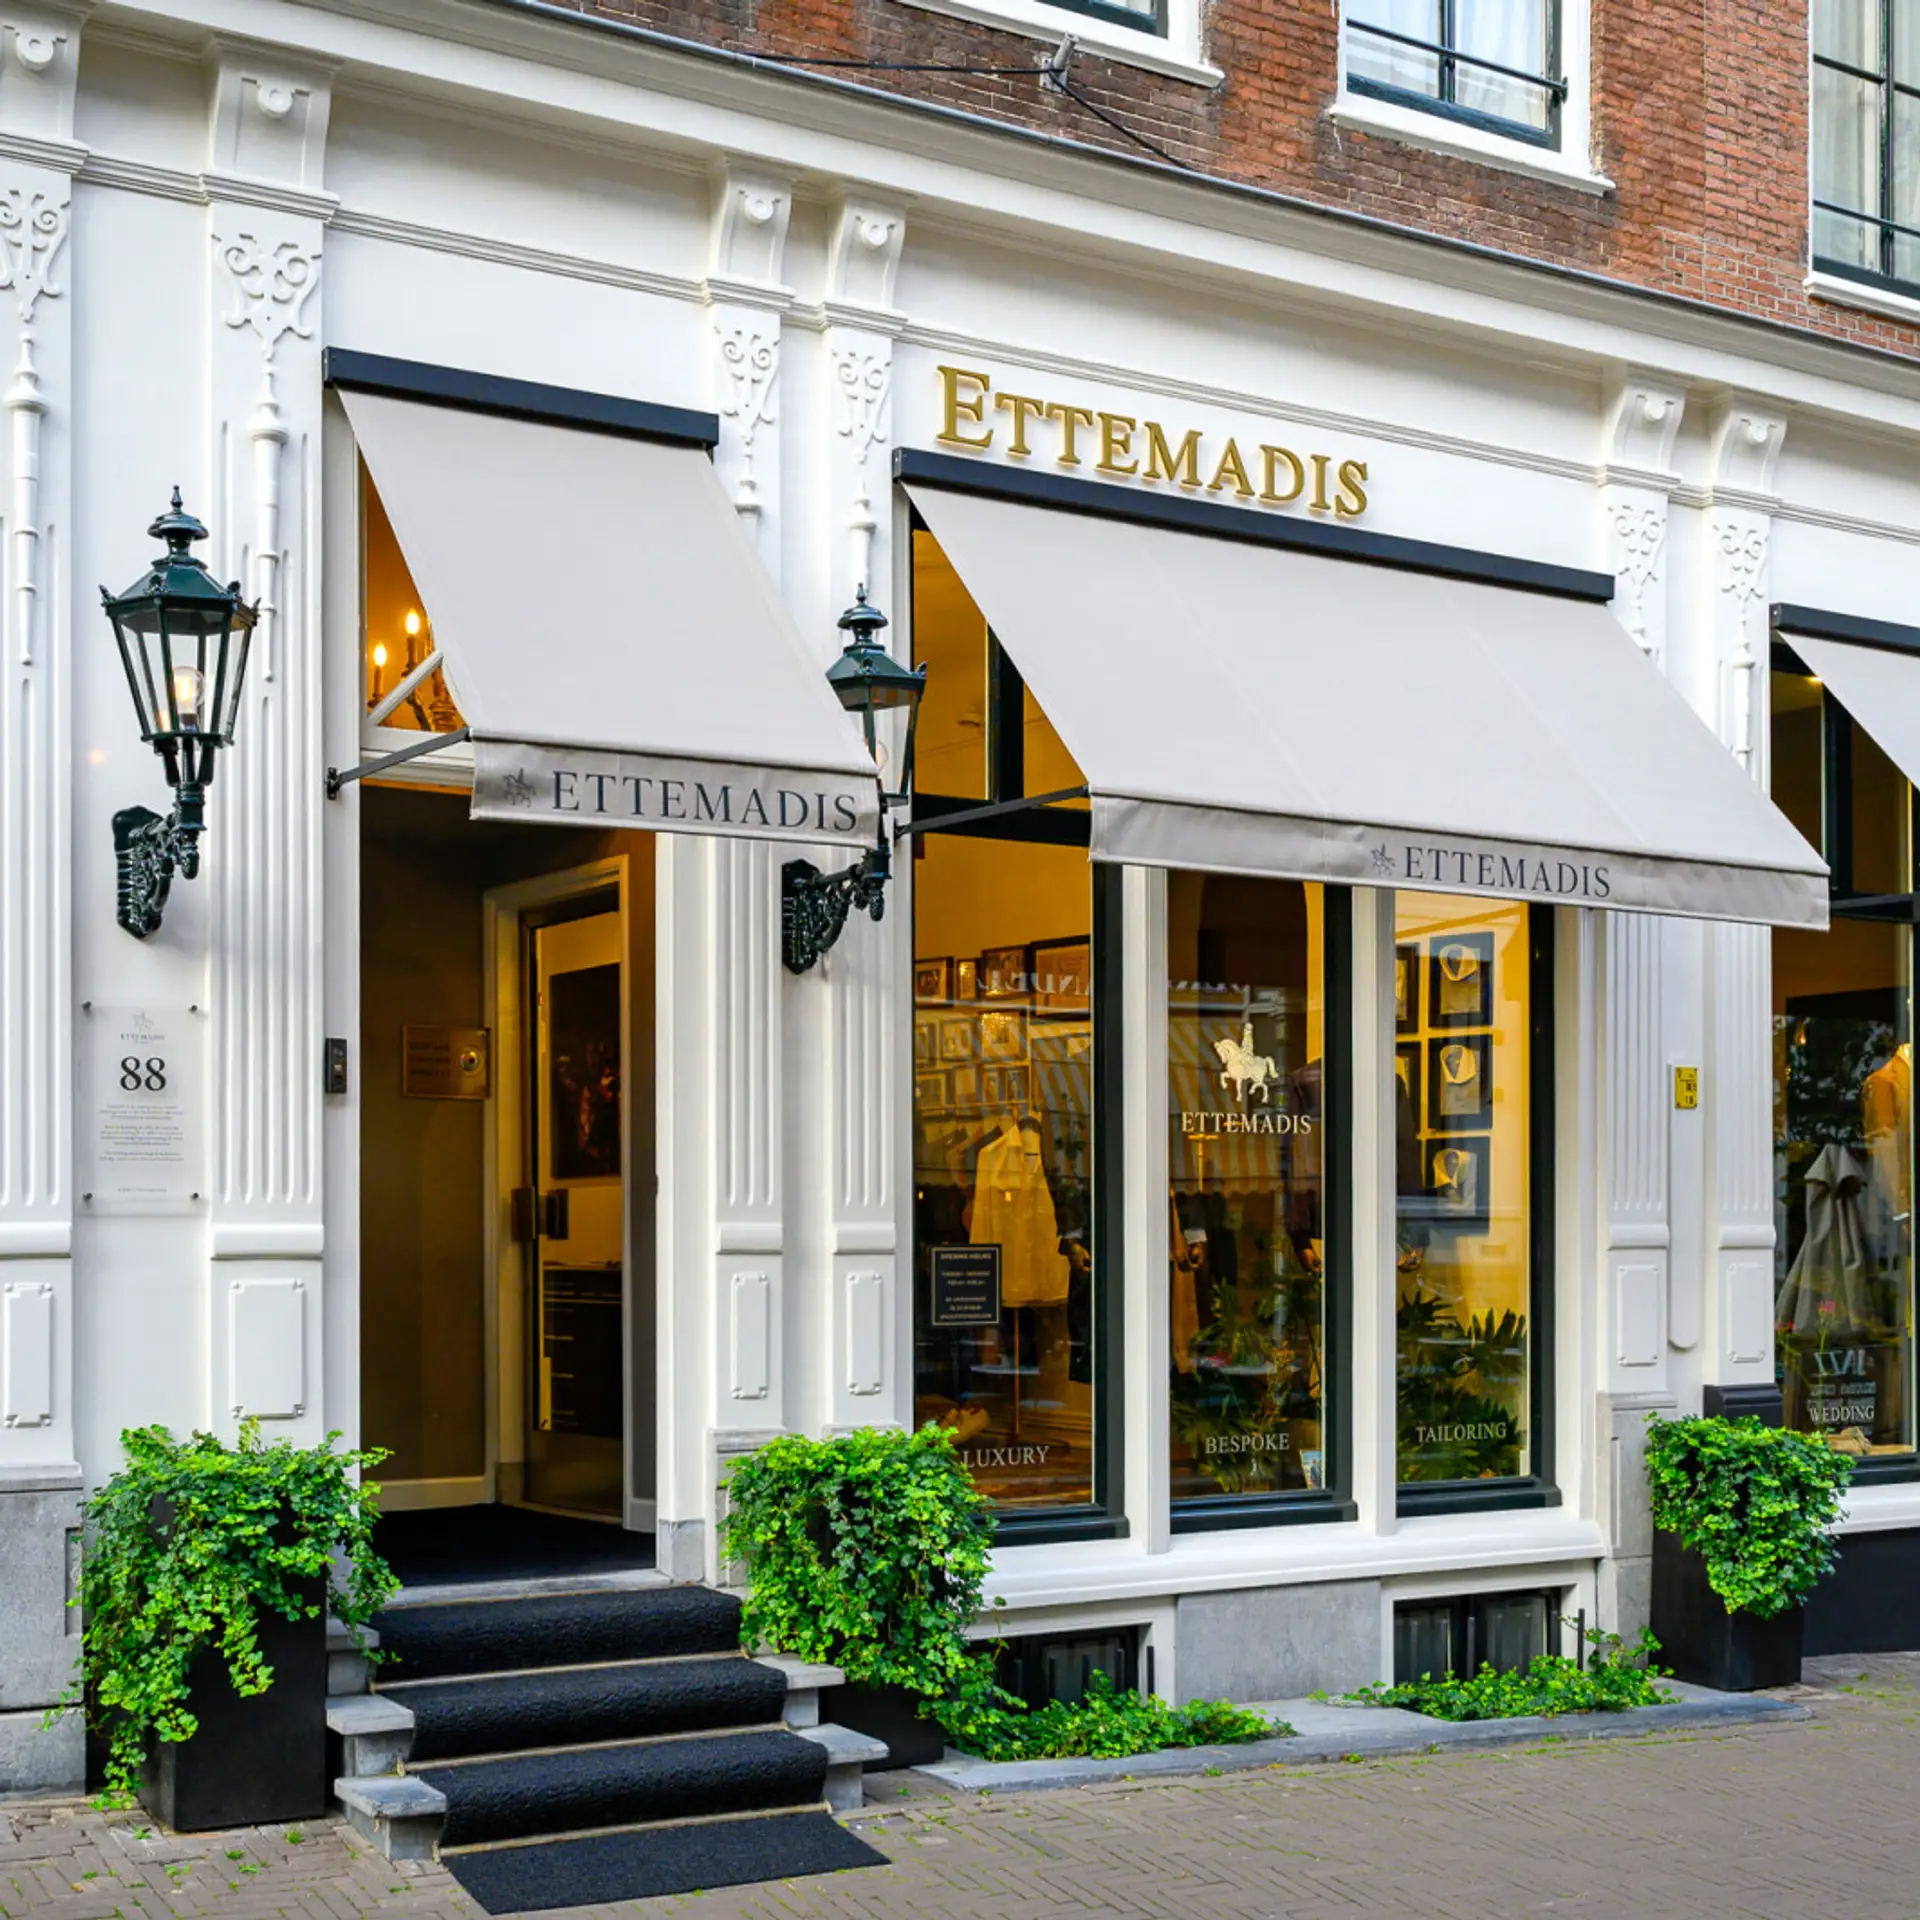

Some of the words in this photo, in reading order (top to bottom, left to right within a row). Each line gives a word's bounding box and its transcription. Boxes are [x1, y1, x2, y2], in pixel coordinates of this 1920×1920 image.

[936, 365, 1368, 516] ETTEMADIS
[552, 771, 857, 832] ETTEMADIS
[1404, 846, 1611, 898] ETTEMADIS
[120, 1056, 166, 1091] 88
[1181, 1111, 1312, 1135] ETTEMADIS
[1809, 1405, 1875, 1422] WEDDING
[1205, 1432, 1290, 1454] BESPOKE
[1415, 1421, 1507, 1443] TAILORING
[963, 1445, 1050, 1468] LUXURY
